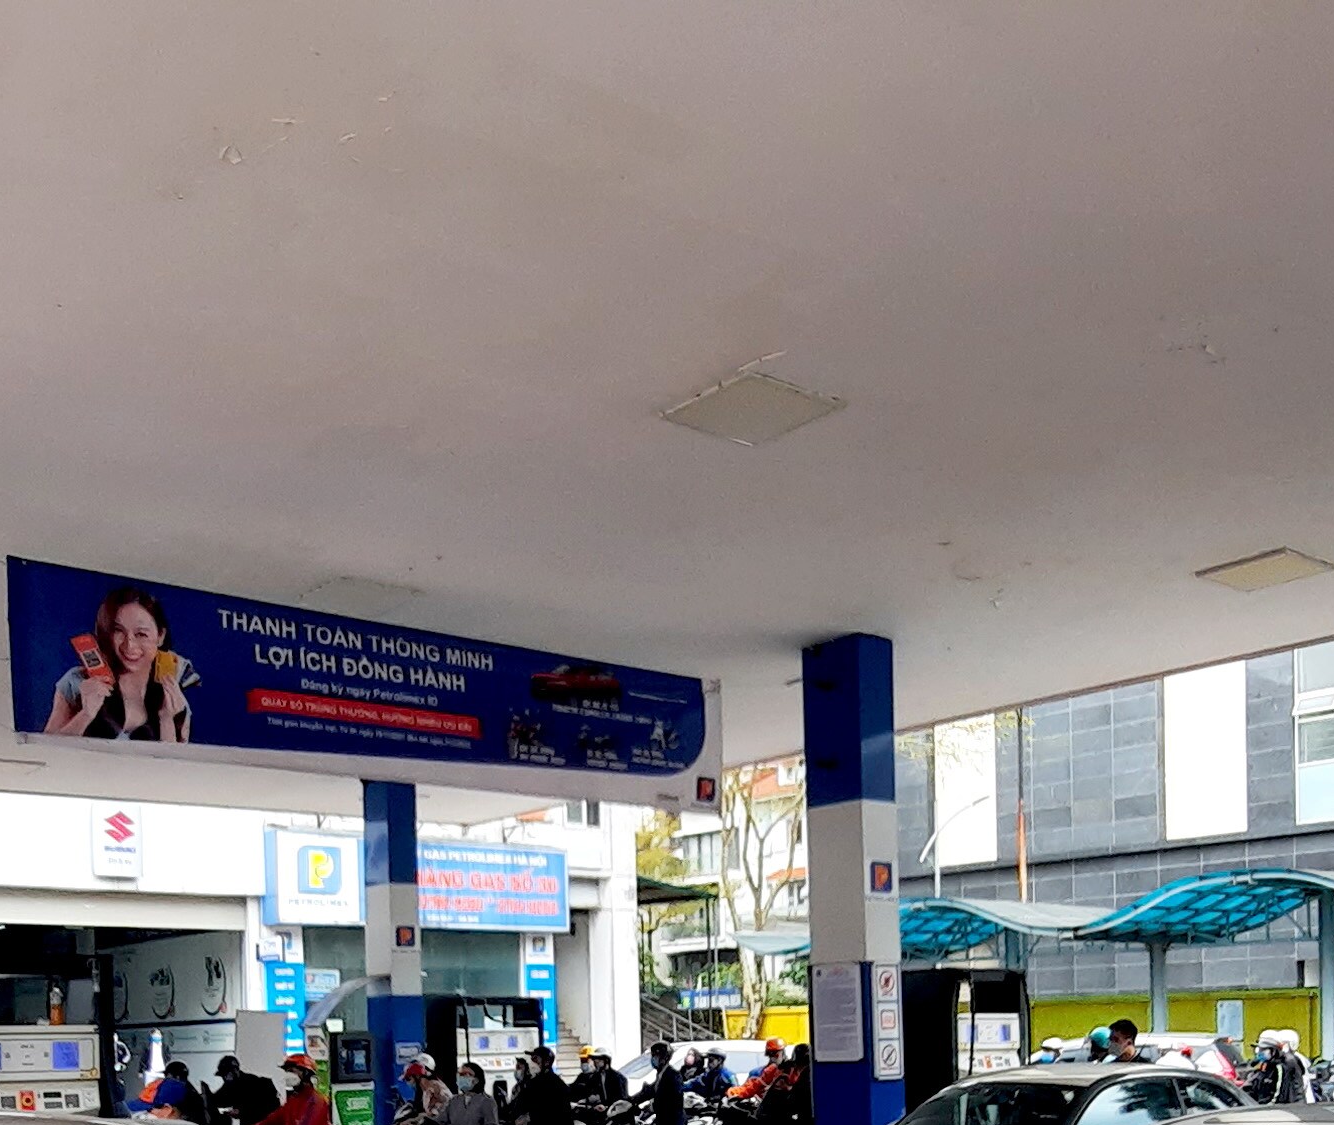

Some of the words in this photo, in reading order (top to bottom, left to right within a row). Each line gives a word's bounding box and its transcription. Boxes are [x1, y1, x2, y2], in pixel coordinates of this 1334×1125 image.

[217, 608, 297, 640] THANH
[367, 635, 441, 663] THÔNG
[446, 647, 494, 672] MINH
[254, 643, 293, 671] LỢI
[299, 645, 337, 675] ÍCH
[342, 655, 405, 684] ĐỒNG
[409, 664, 467, 693] HÀNH
